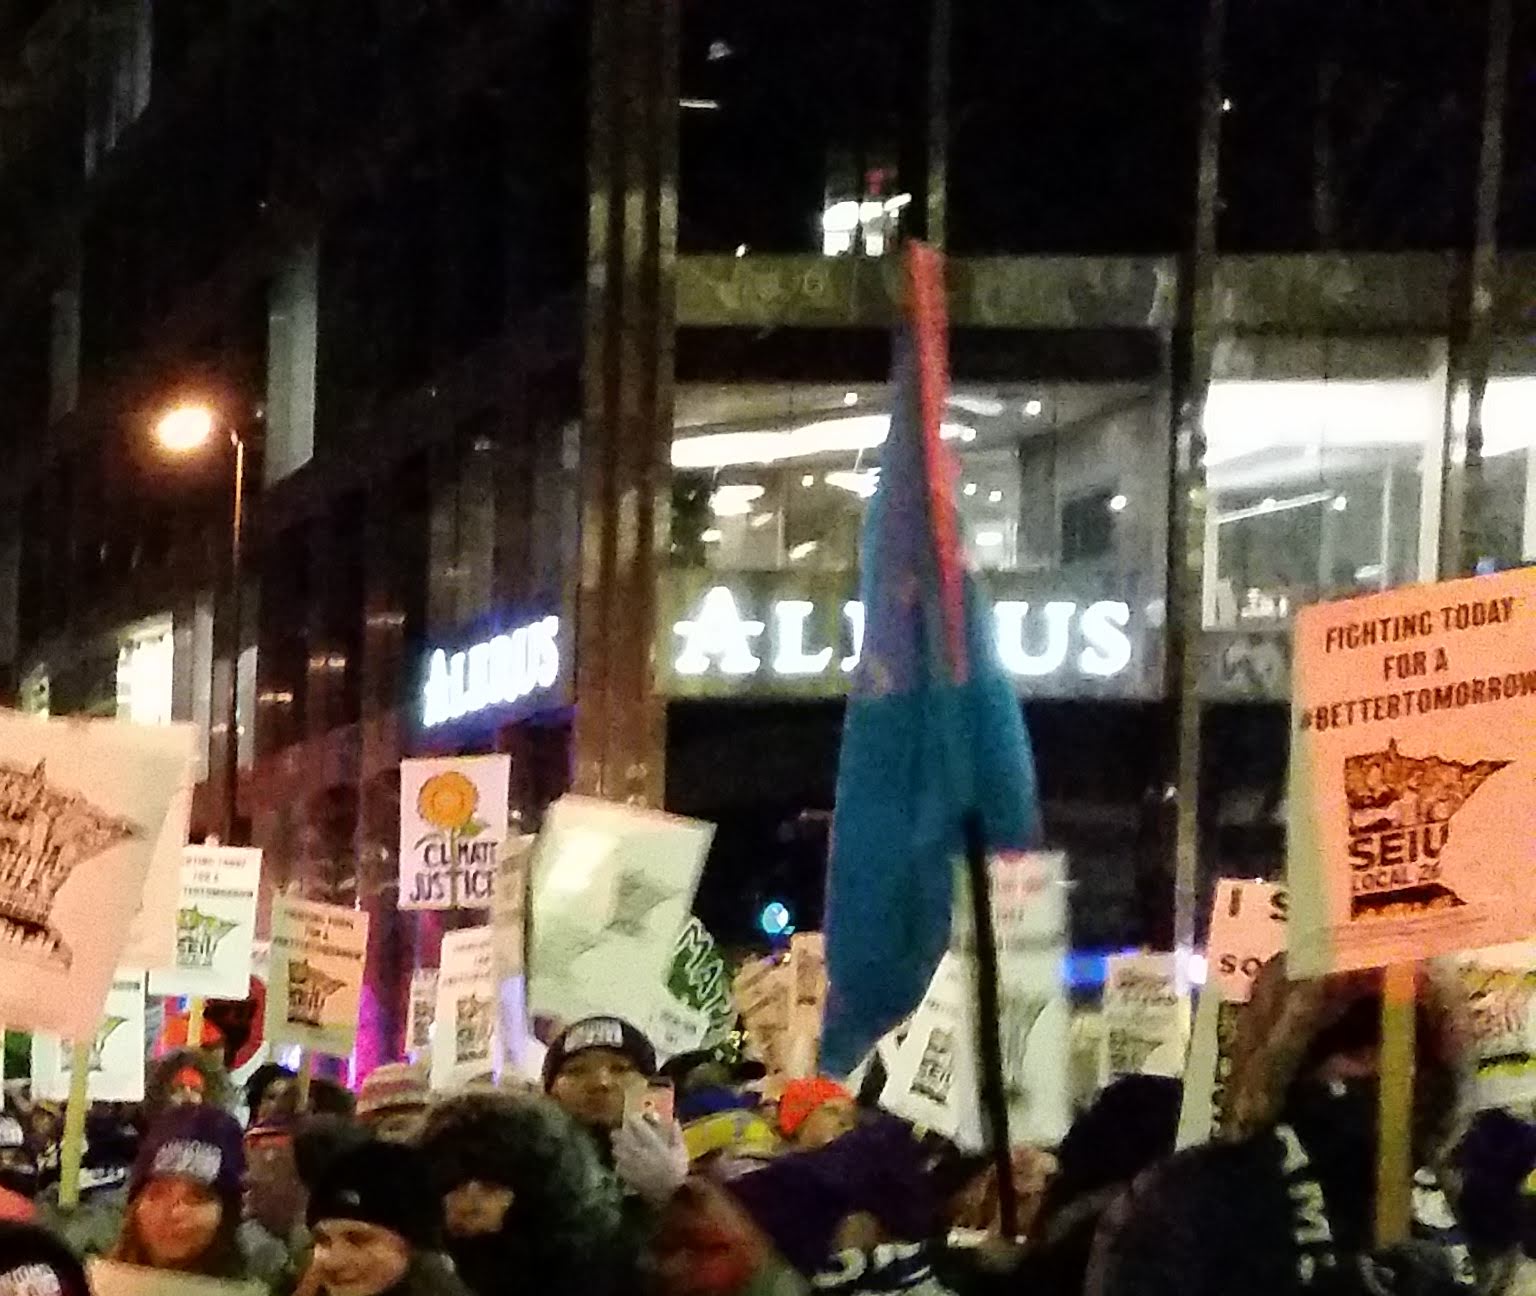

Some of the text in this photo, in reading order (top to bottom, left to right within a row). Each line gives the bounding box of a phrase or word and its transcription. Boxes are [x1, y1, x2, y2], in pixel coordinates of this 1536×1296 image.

[672, 586, 1132, 676] ALUS
[1324, 596, 1516, 653] FIGHTING TODAY
[1383, 647, 1449, 682] FOR A
[1348, 824, 1449, 872] SEIU
[1269, 890, 1287, 922] S
